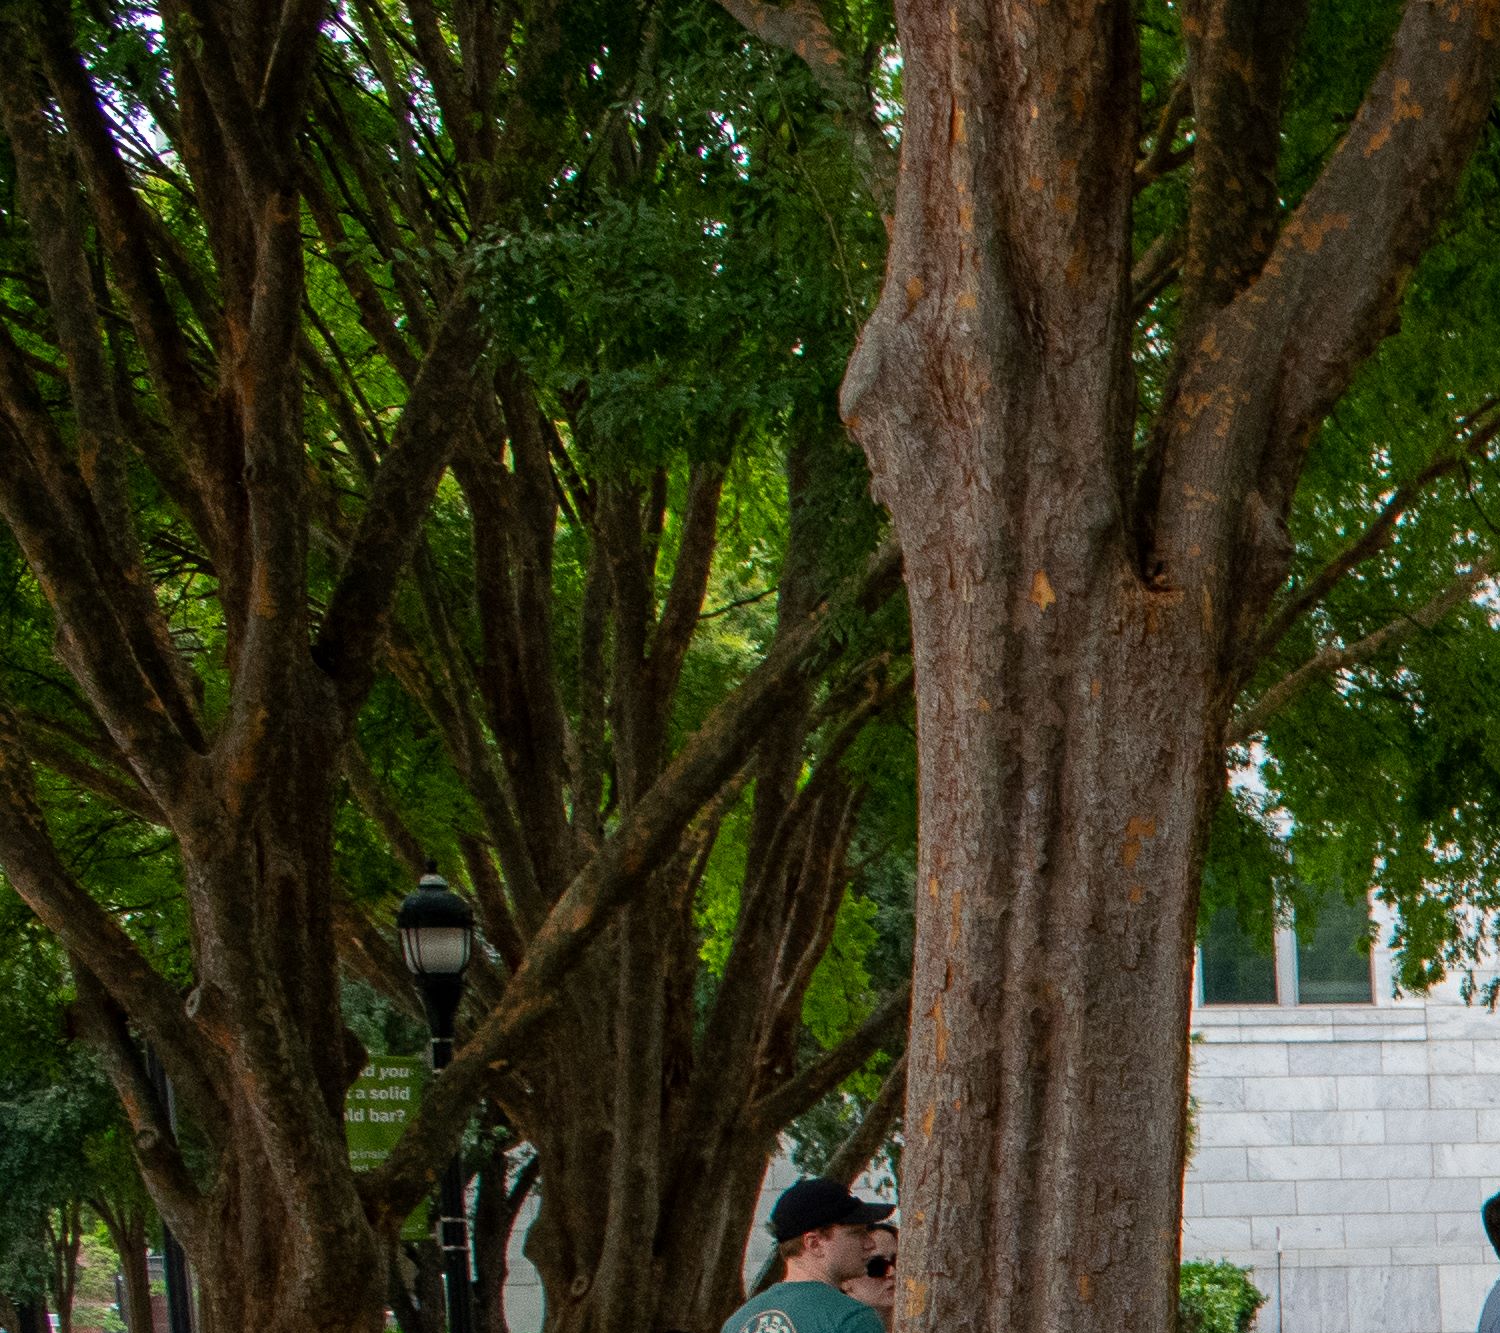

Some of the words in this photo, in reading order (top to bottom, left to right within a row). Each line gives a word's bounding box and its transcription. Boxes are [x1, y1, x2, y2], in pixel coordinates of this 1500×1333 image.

[355, 1088, 366, 1100] a
[369, 1086, 411, 1101] solid
[369, 1109, 406, 1123] bar?
